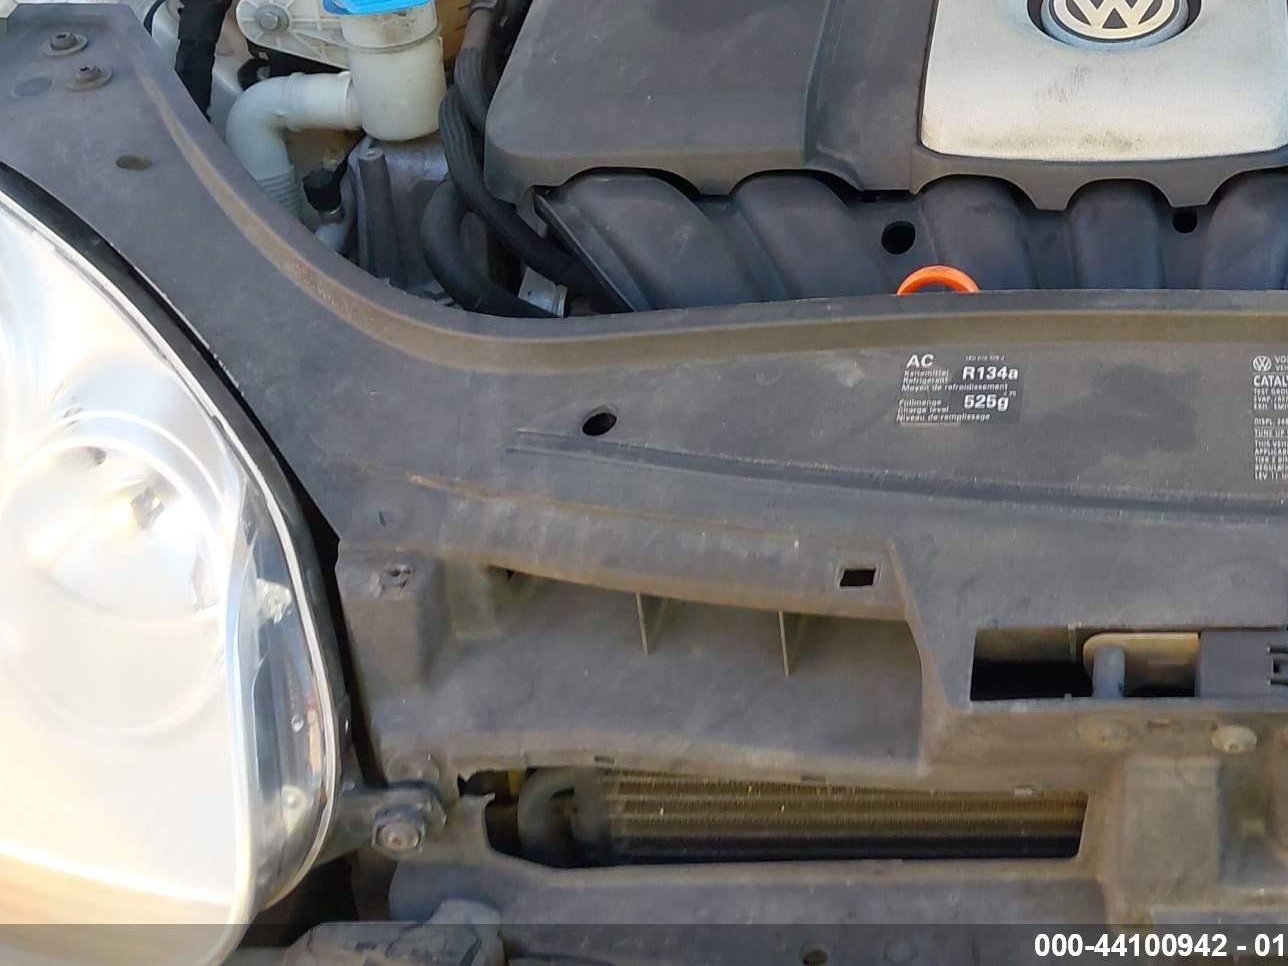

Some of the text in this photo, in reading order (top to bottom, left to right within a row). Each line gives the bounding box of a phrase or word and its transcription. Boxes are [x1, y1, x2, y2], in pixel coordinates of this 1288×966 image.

[906, 354, 934, 369] AC
[962, 365, 1019, 381] R134a
[964, 394, 1009, 411] 525g
